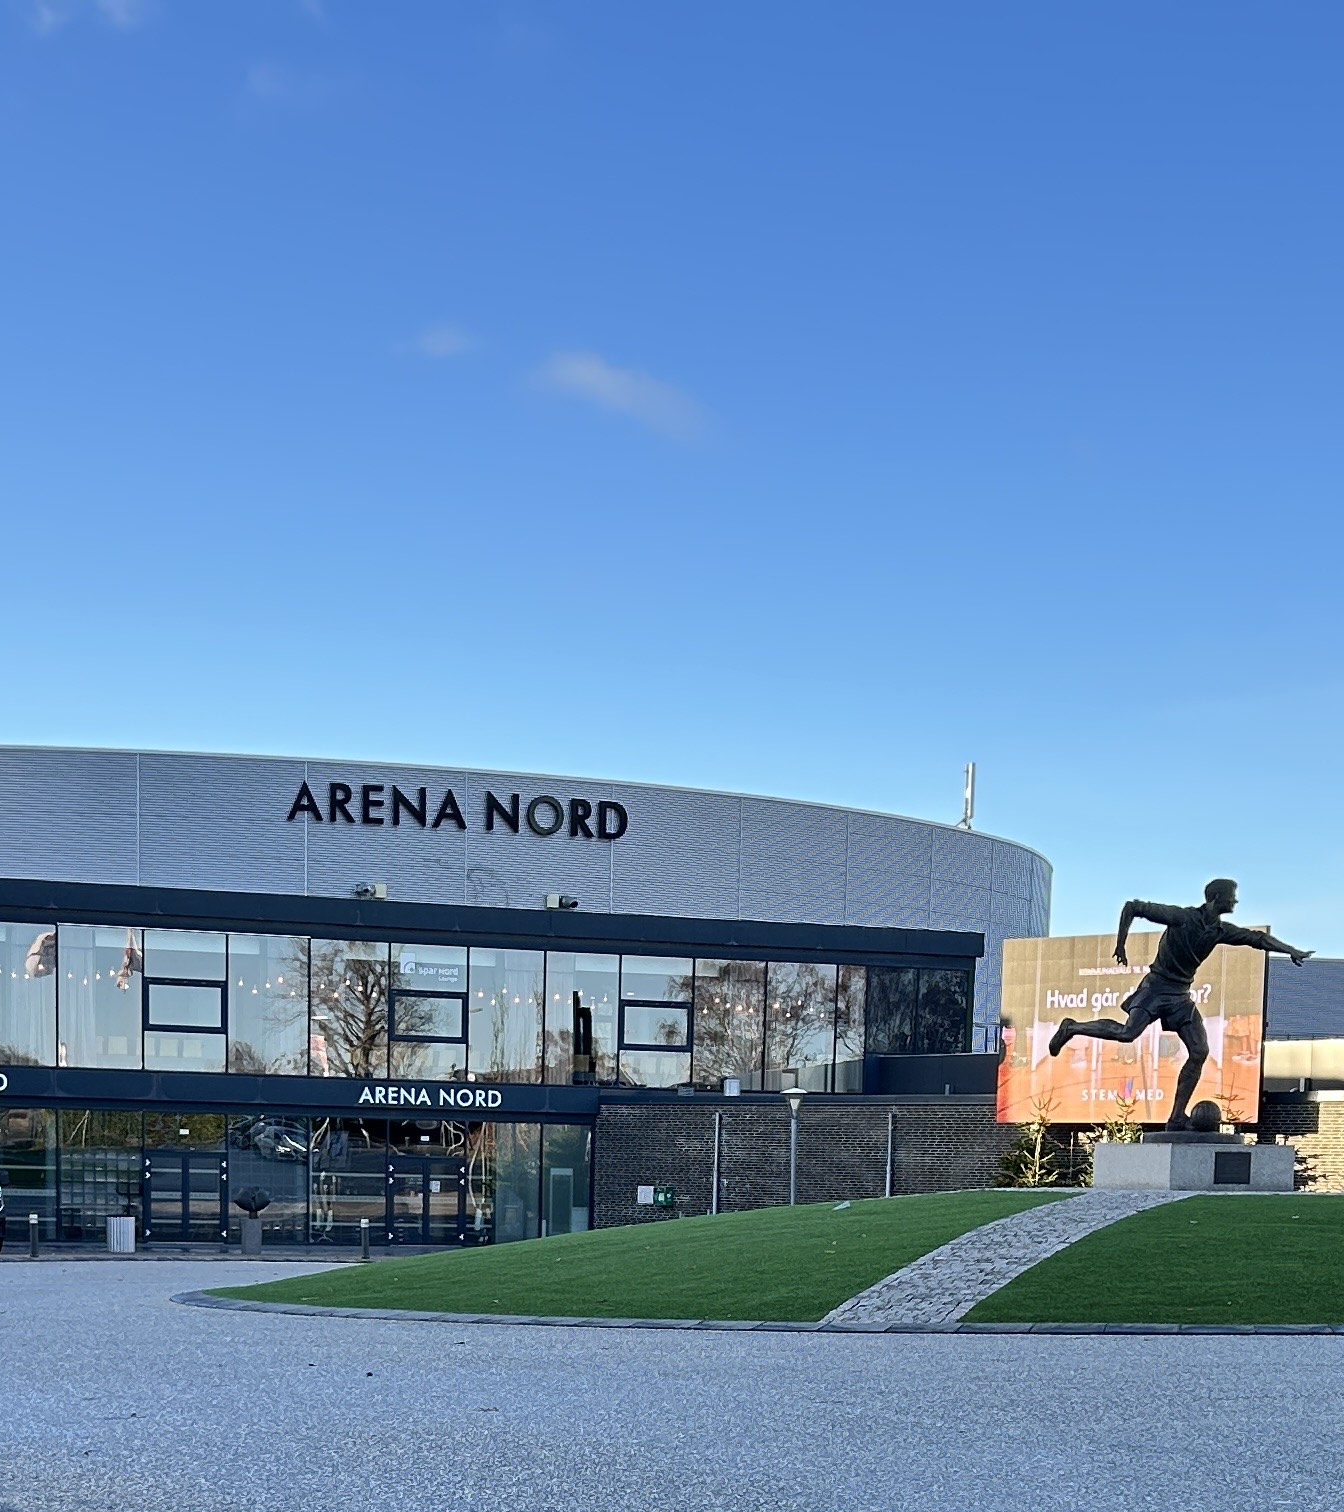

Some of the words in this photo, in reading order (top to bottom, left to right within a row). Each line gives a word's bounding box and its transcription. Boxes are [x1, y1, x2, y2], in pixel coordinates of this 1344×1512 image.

[287, 781, 467, 830] ARENA
[485, 790, 629, 840] NORD
[1046, 988, 1088, 1009] Hvad
[1091, 987, 1119, 1012] går
[358, 1086, 432, 1106] ARENA
[439, 1088, 502, 1108] NORD
[1081, 1089, 1117, 1101] STEM
[1135, 1089, 1164, 1101] MED
